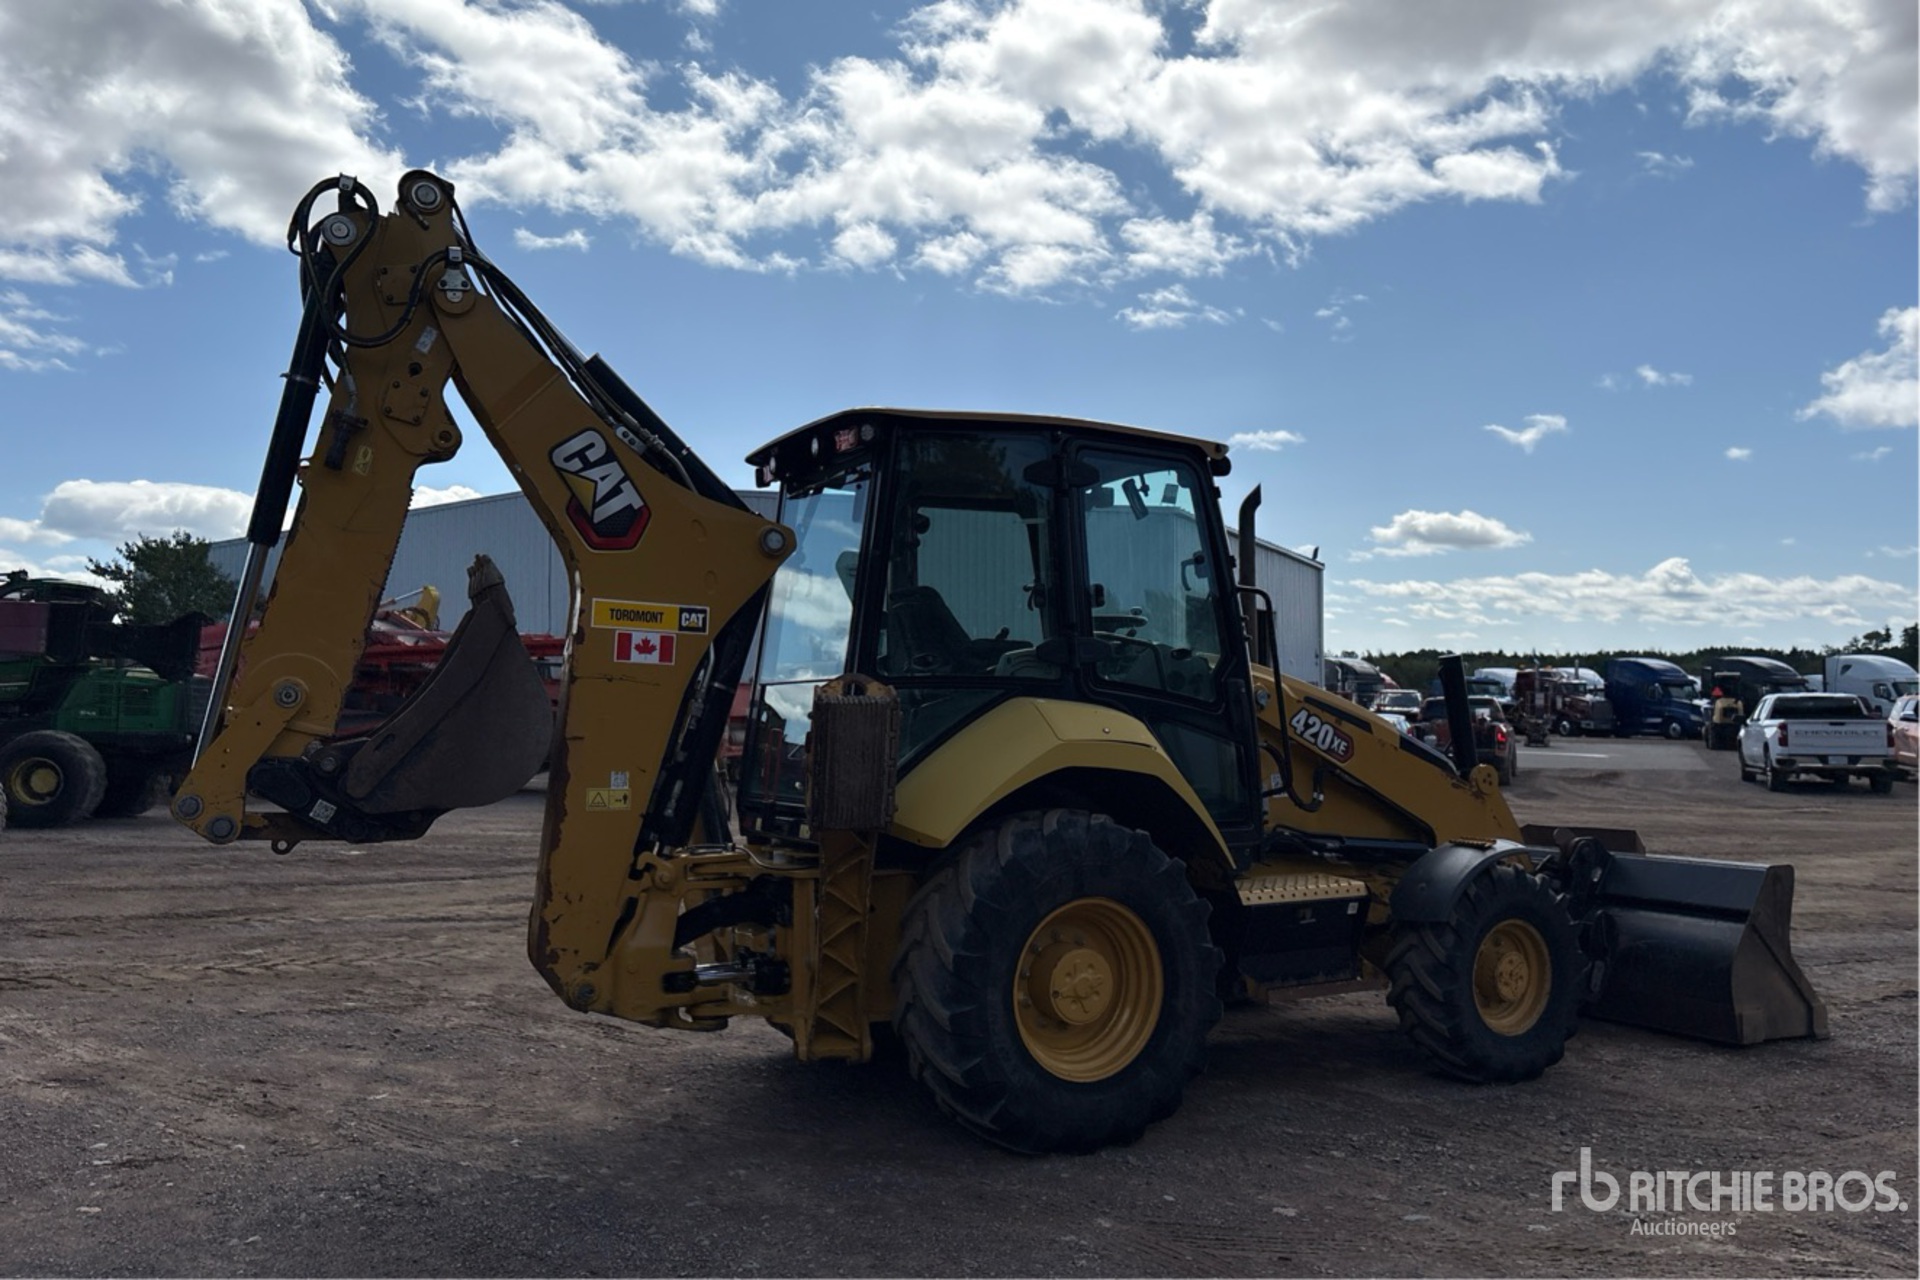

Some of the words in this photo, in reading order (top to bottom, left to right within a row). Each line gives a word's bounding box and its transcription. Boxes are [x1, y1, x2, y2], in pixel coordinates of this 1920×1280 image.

[551, 430, 644, 524] CAT
[609, 608, 664, 624] TOROMONT
[681, 612, 705, 628] CAT
[1793, 729, 1881, 737] CHEVROLET
